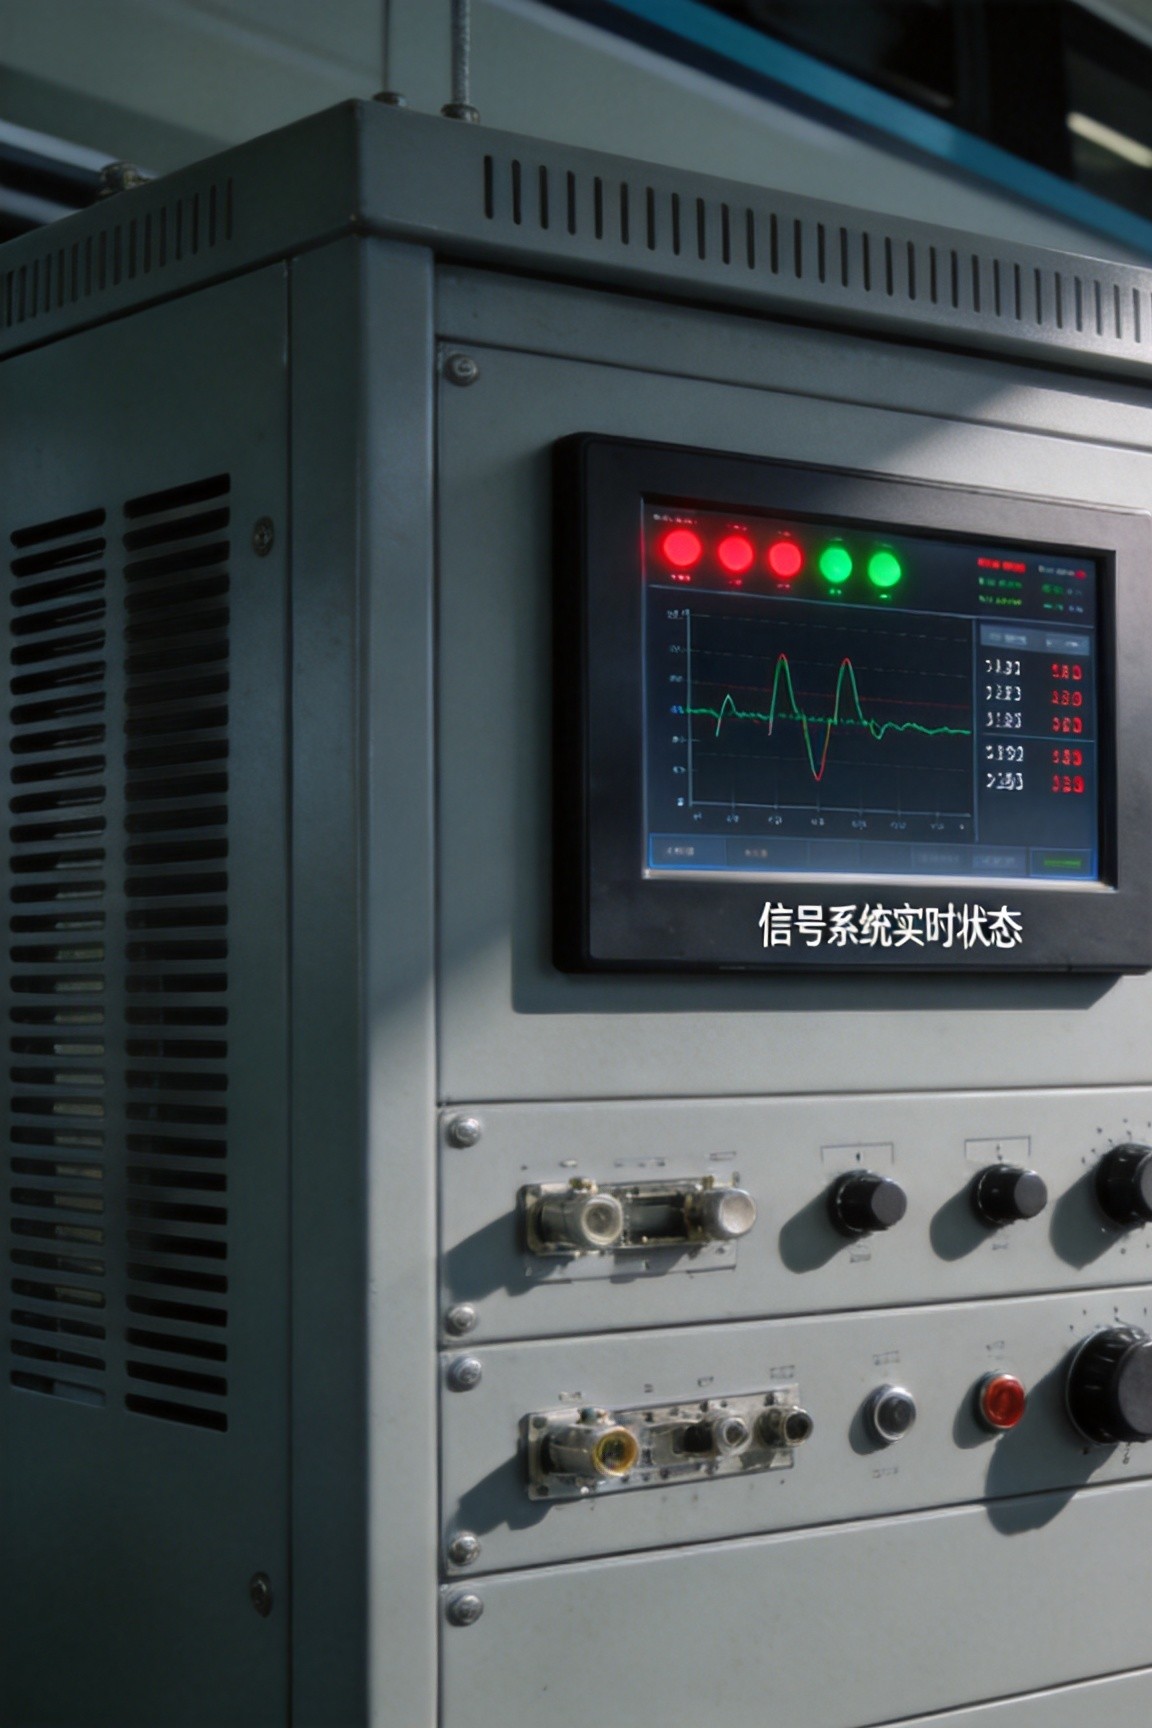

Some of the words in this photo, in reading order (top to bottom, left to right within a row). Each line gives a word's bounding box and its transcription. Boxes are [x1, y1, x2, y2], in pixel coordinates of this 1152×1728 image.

[759, 902, 1023, 949] 信号系统实时状态
